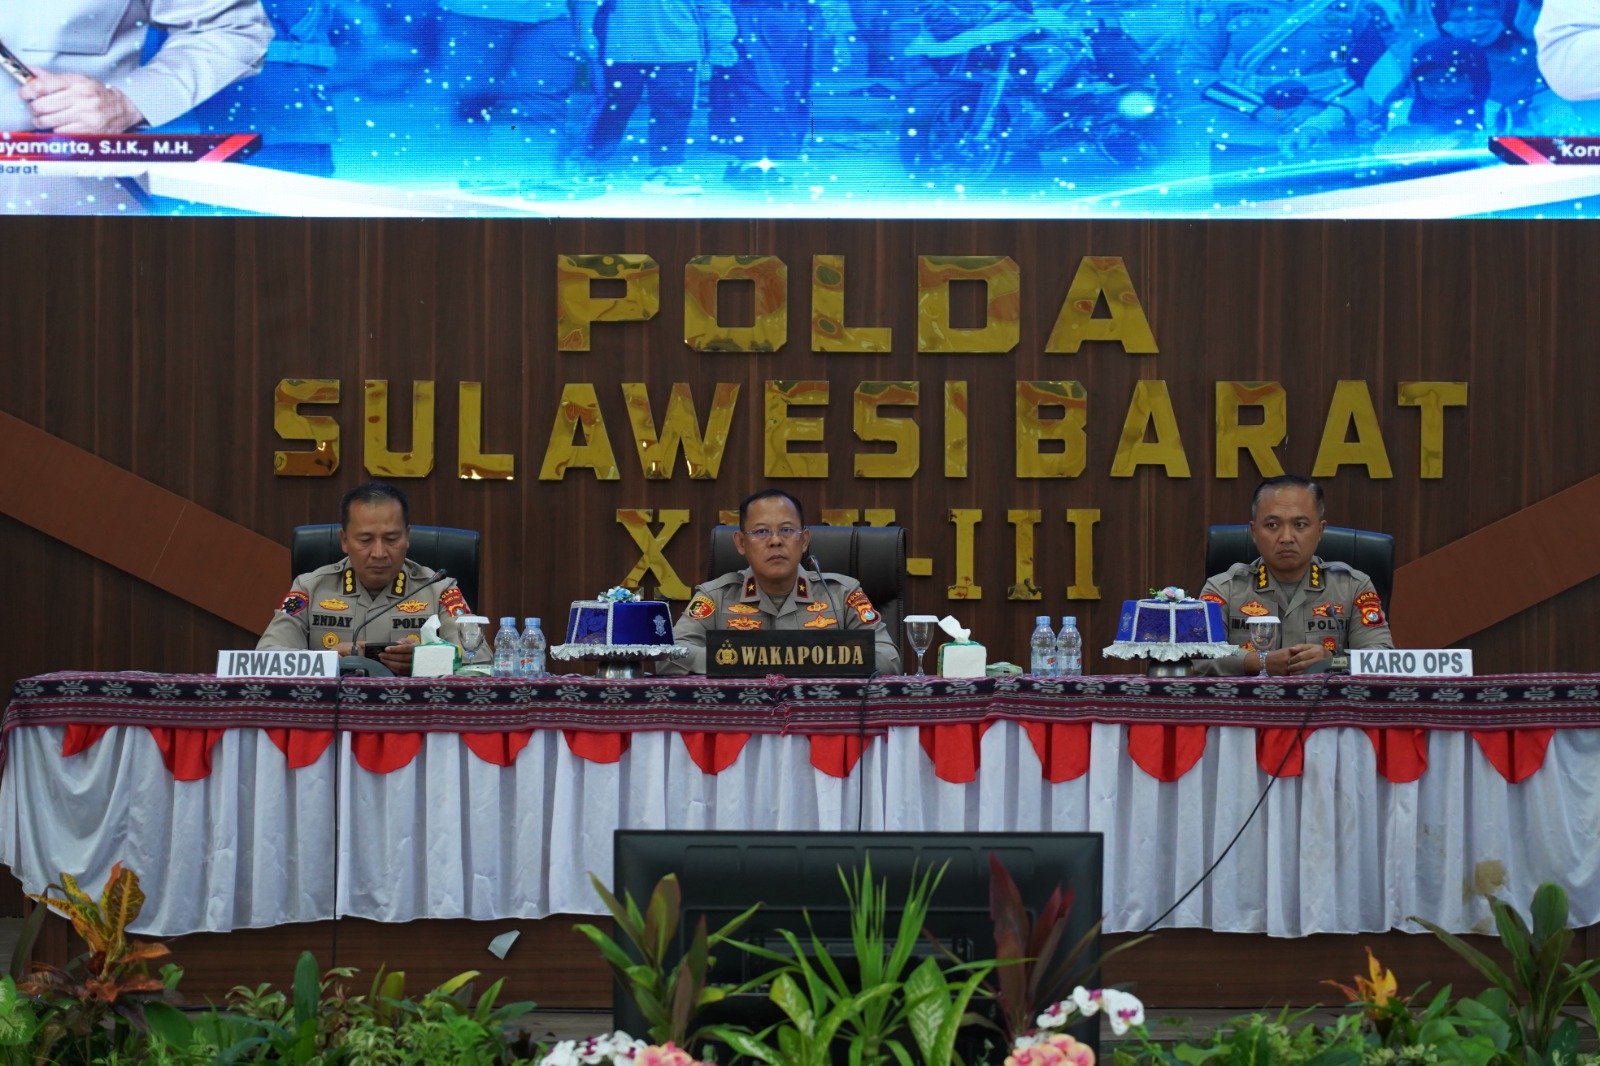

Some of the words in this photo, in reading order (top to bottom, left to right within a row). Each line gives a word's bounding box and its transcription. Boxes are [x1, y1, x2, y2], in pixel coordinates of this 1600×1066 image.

[99, 140, 148, 156] S.I.K.,
[153, 141, 193, 154] M.H.
[557, 254, 1159, 353] POLDA
[274, 379, 968, 480] SULAWESI
[1016, 379, 1467, 478] BARAT
[312, 615, 352, 627] ENDAY
[392, 617, 430, 629] POLR
[228, 652, 325, 676] IRWASDA
[741, 645, 864, 665] WAKAPOLDA
[1360, 652, 1416, 673] KARO
[1423, 652, 1463, 673] OPS
